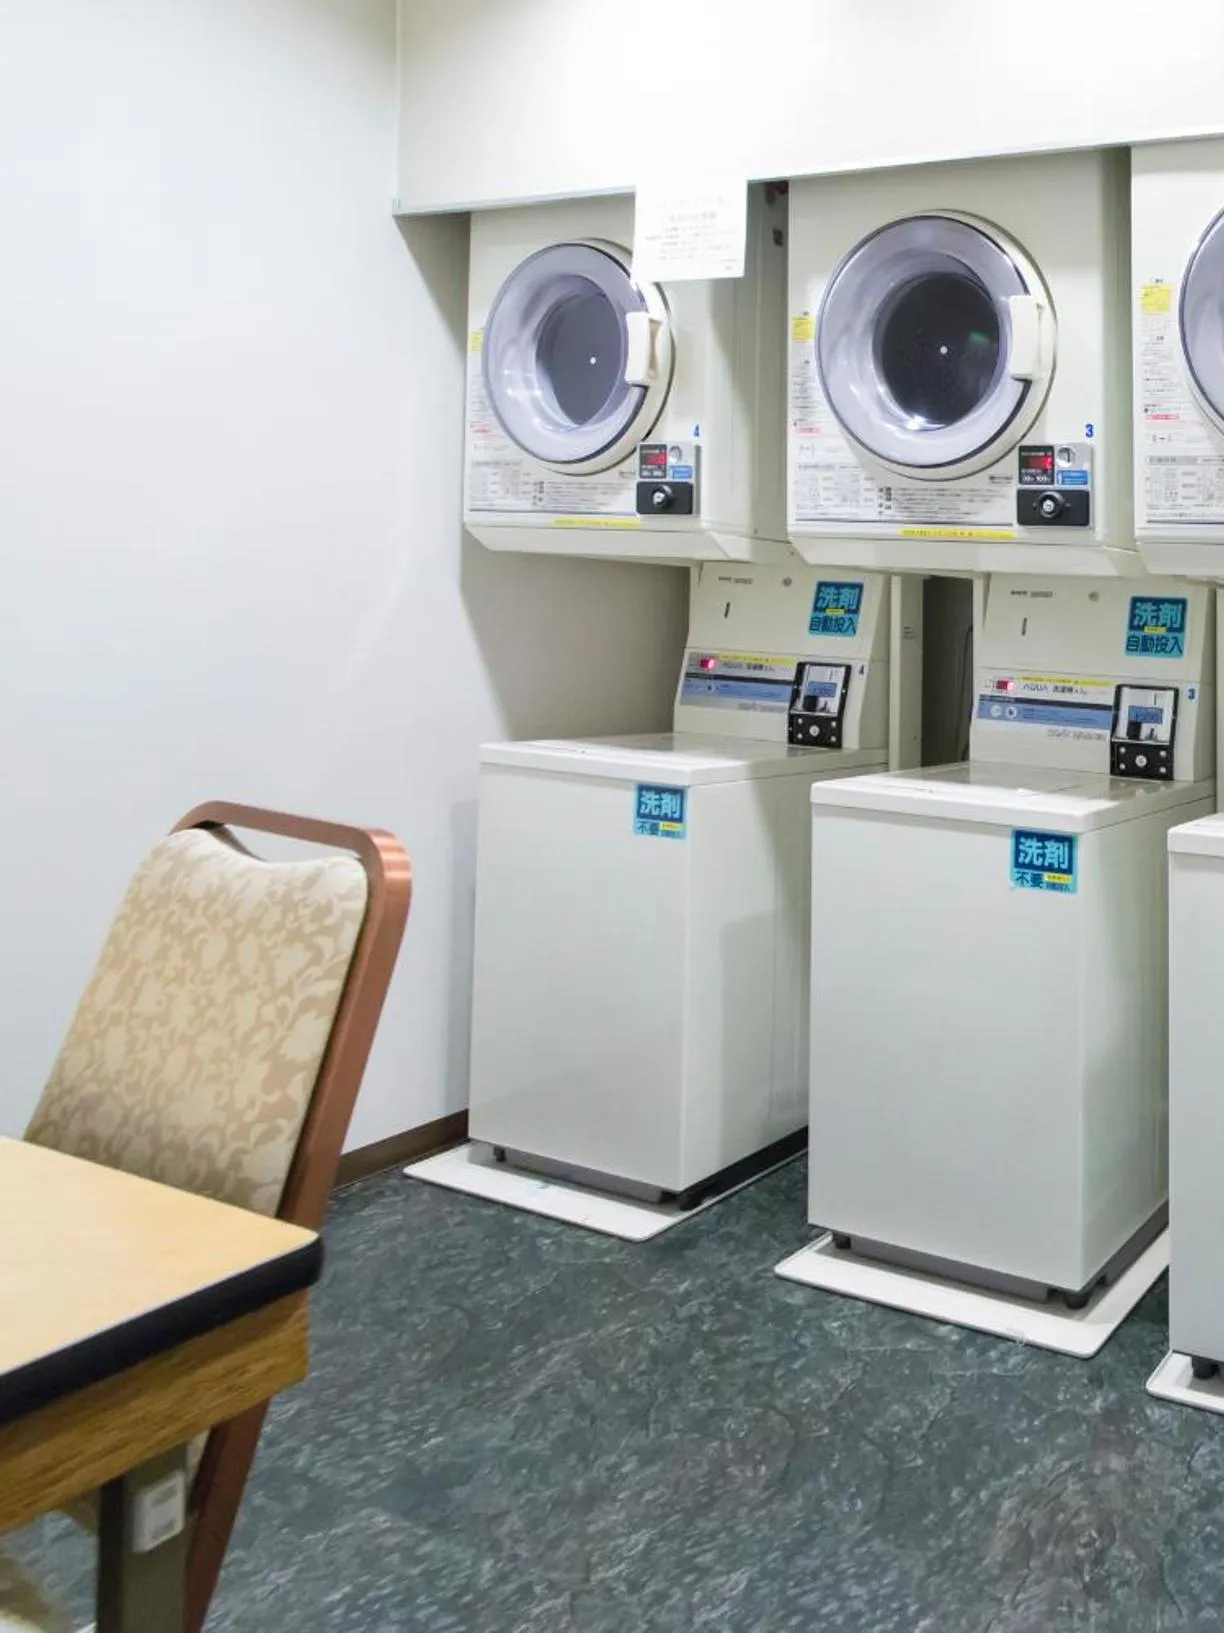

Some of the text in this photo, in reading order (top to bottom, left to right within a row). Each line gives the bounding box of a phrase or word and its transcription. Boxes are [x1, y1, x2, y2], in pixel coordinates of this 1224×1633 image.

[1085, 424, 1094, 438] 3
[819, 586, 860, 608] 洗剤
[1135, 602, 1182, 627] 洗剤
[1126, 635, 1183, 655] 自動投入
[1188, 688, 1196, 700] 3
[640, 790, 681, 818] 洗剤
[1018, 836, 1069, 869] 洗剤
